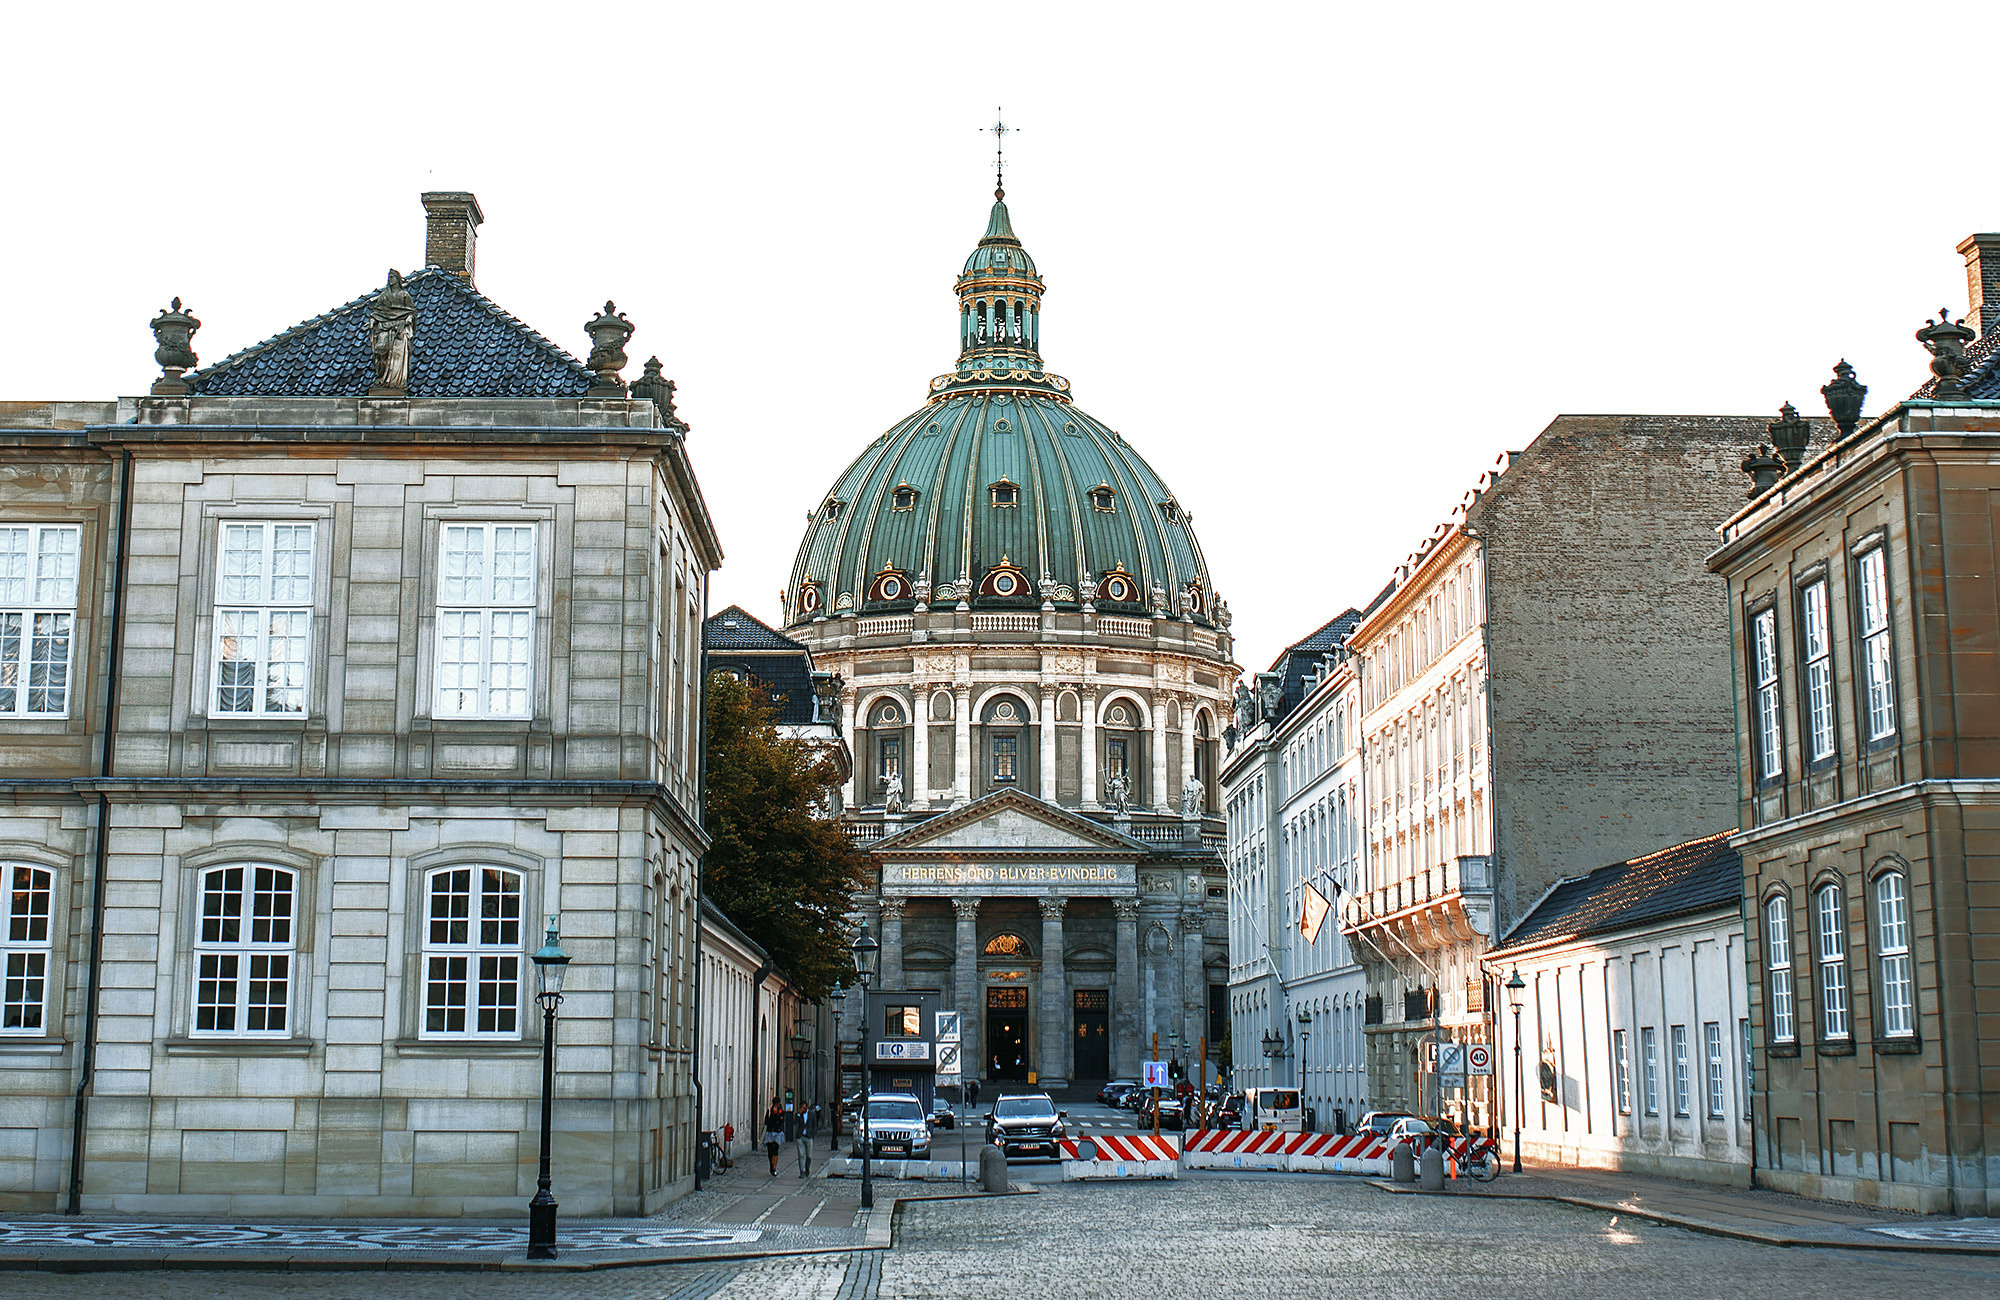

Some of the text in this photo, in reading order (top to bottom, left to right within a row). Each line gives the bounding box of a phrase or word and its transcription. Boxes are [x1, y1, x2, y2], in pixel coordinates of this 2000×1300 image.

[902, 867, 1117, 880] HERRENS ORD BLIVER EVINDELIG
[1473, 1053, 1485, 1062] 40
